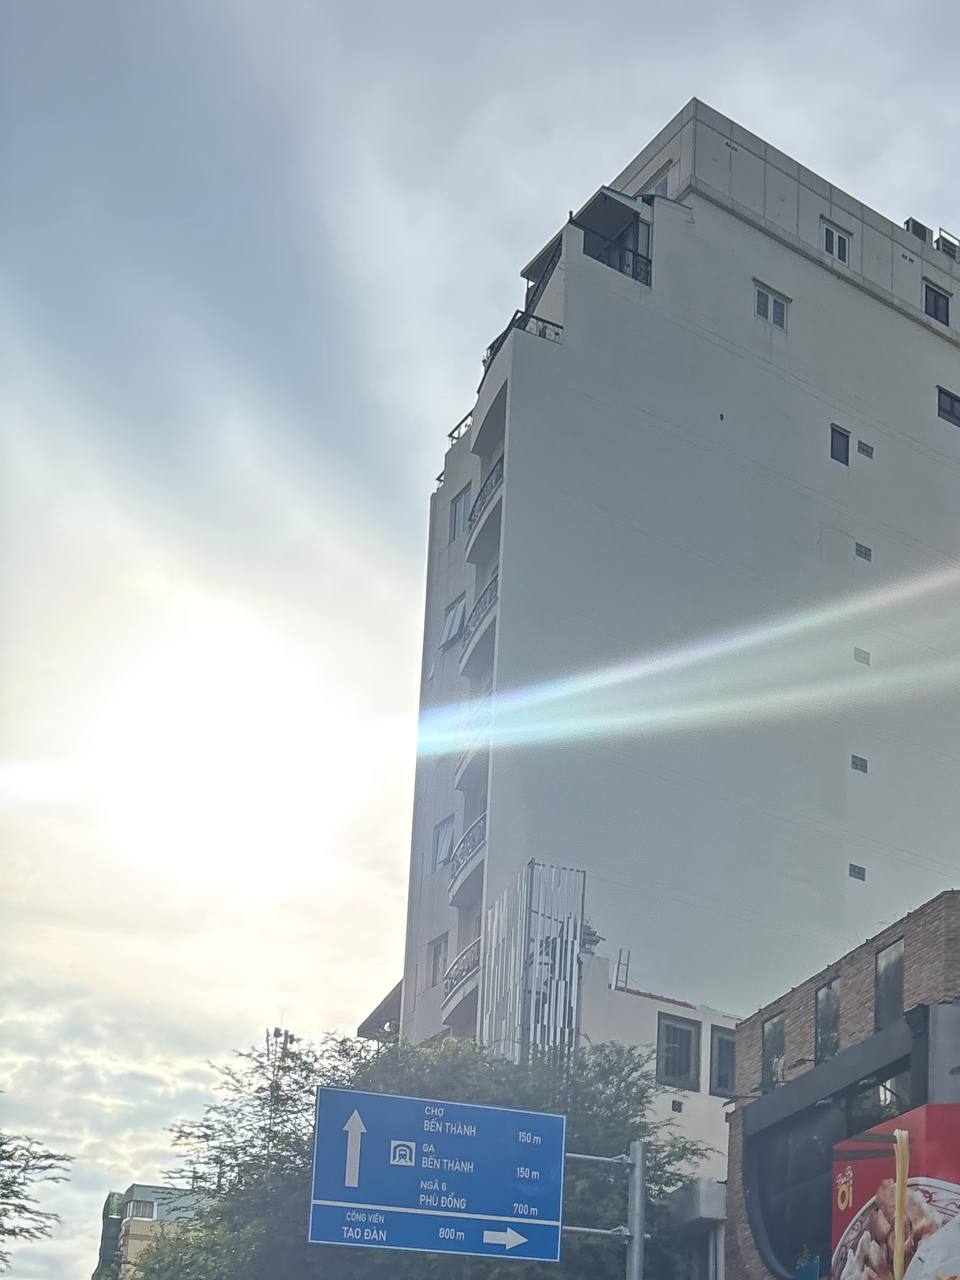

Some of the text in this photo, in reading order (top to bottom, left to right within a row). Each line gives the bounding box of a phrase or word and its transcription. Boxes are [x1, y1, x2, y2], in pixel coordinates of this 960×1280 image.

[423, 1117, 443, 1133] BẾN
[518, 1131, 541, 1145] 150 m
[422, 1143, 435, 1153] GA
[421, 1154, 441, 1169] BẾN
[517, 1167, 540, 1180] 150 m
[441, 1182, 447, 1191] 6
[513, 1203, 538, 1216] 700 m
[342, 1226, 387, 1241] TAO ĐÀN
[438, 1227, 465, 1241] 800 m
